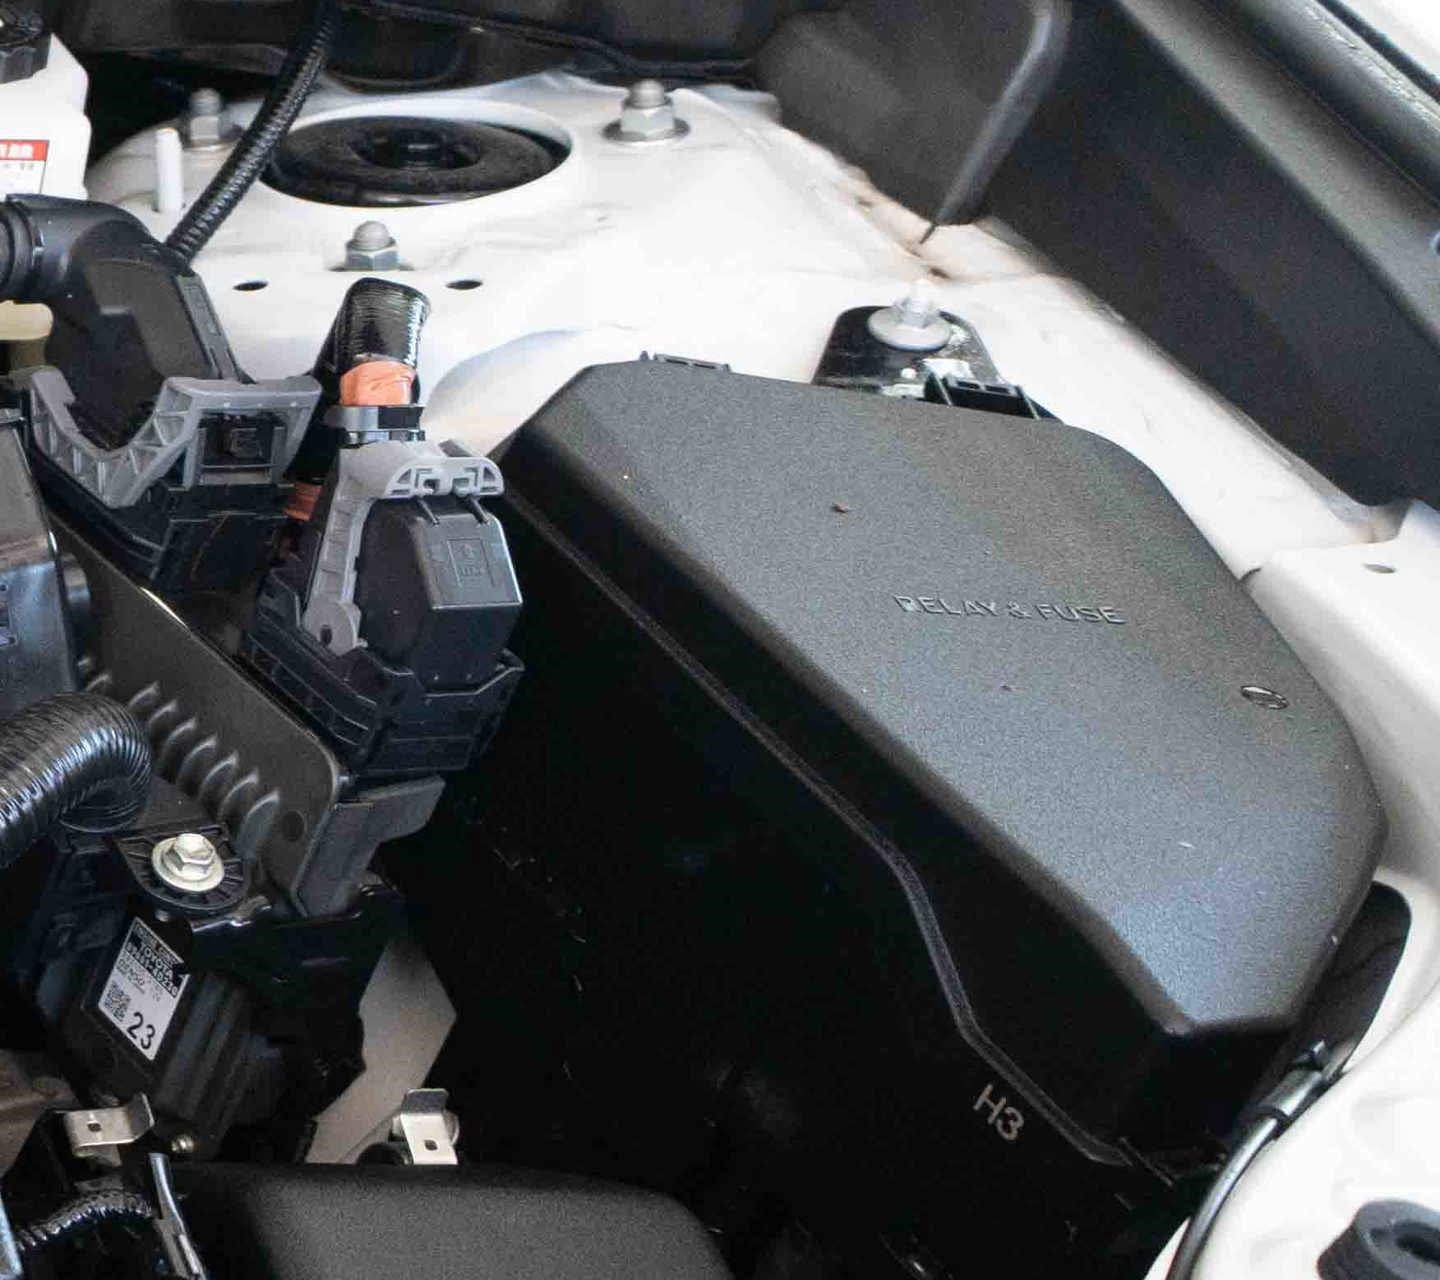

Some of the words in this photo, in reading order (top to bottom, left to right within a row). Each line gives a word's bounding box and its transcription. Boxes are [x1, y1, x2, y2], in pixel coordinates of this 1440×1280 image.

[894, 595, 998, 617] RELAY
[1006, 600, 1032, 620] &
[1035, 603, 1126, 625] FUSE
[138, 940, 175, 981] TOYOTA
[126, 1008, 157, 1053] 23
[973, 1083, 1025, 1140] H3
